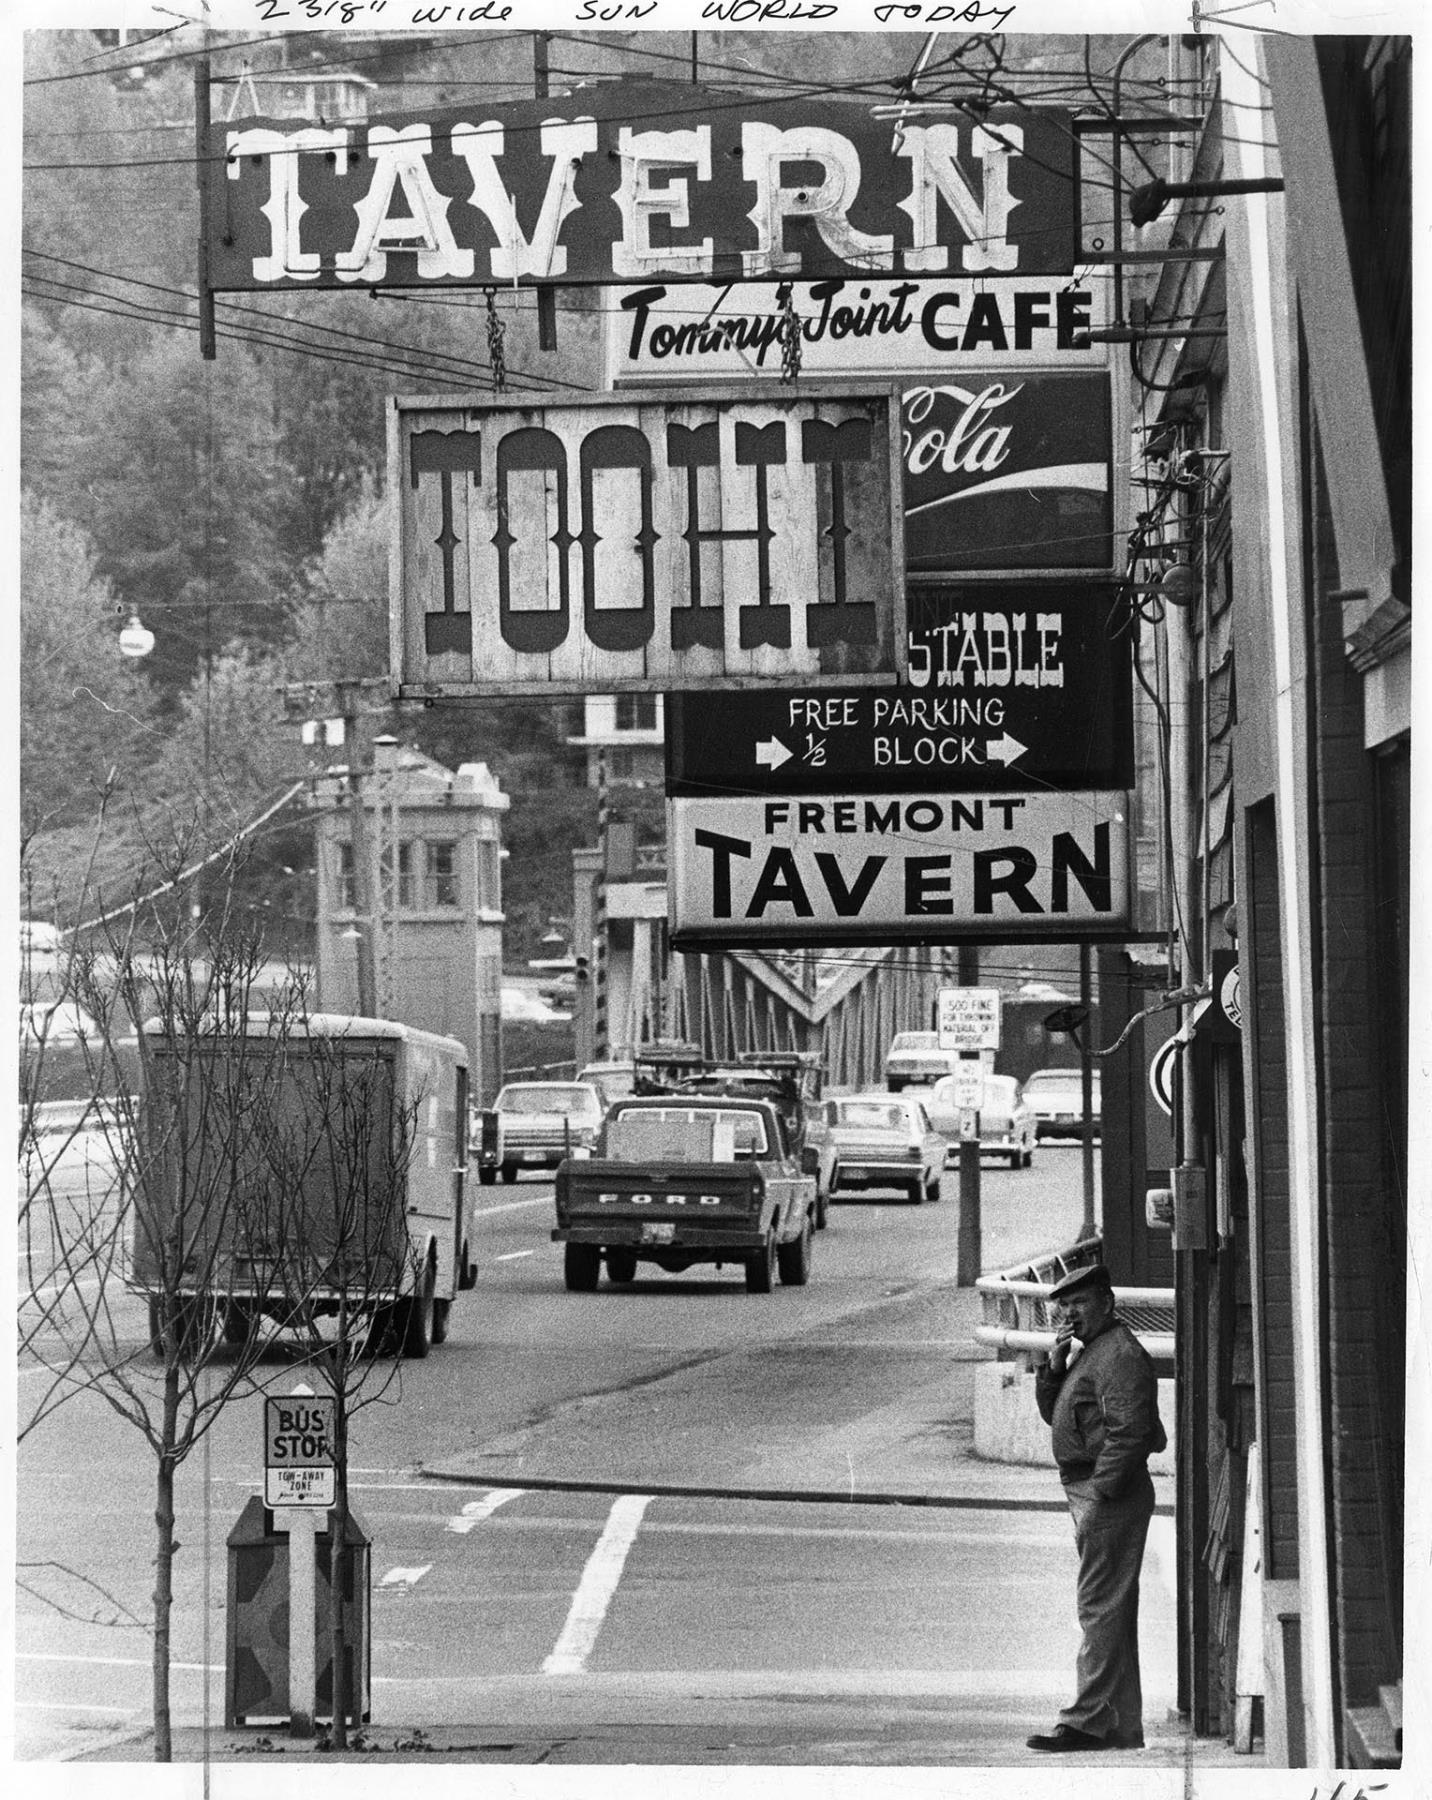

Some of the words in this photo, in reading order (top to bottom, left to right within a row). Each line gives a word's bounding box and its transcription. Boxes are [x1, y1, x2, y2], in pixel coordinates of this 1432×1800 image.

[225, 116, 1024, 281] TAVERN
[802, 281, 920, 342] Joint
[921, 291, 1093, 352] CAFE
[789, 698, 861, 730] FREE
[873, 698, 1006, 730] PARKING
[873, 737, 988, 766] BLOCK
[764, 798, 1026, 835] FREMONT
[694, 821, 1112, 919] TAVERN
[599, 1193, 721, 1205] FORD
[279, 1409, 325, 1432] BUS
[273, 1435, 328, 1458] STOP
[290, 1481, 313, 1491] ZONE
